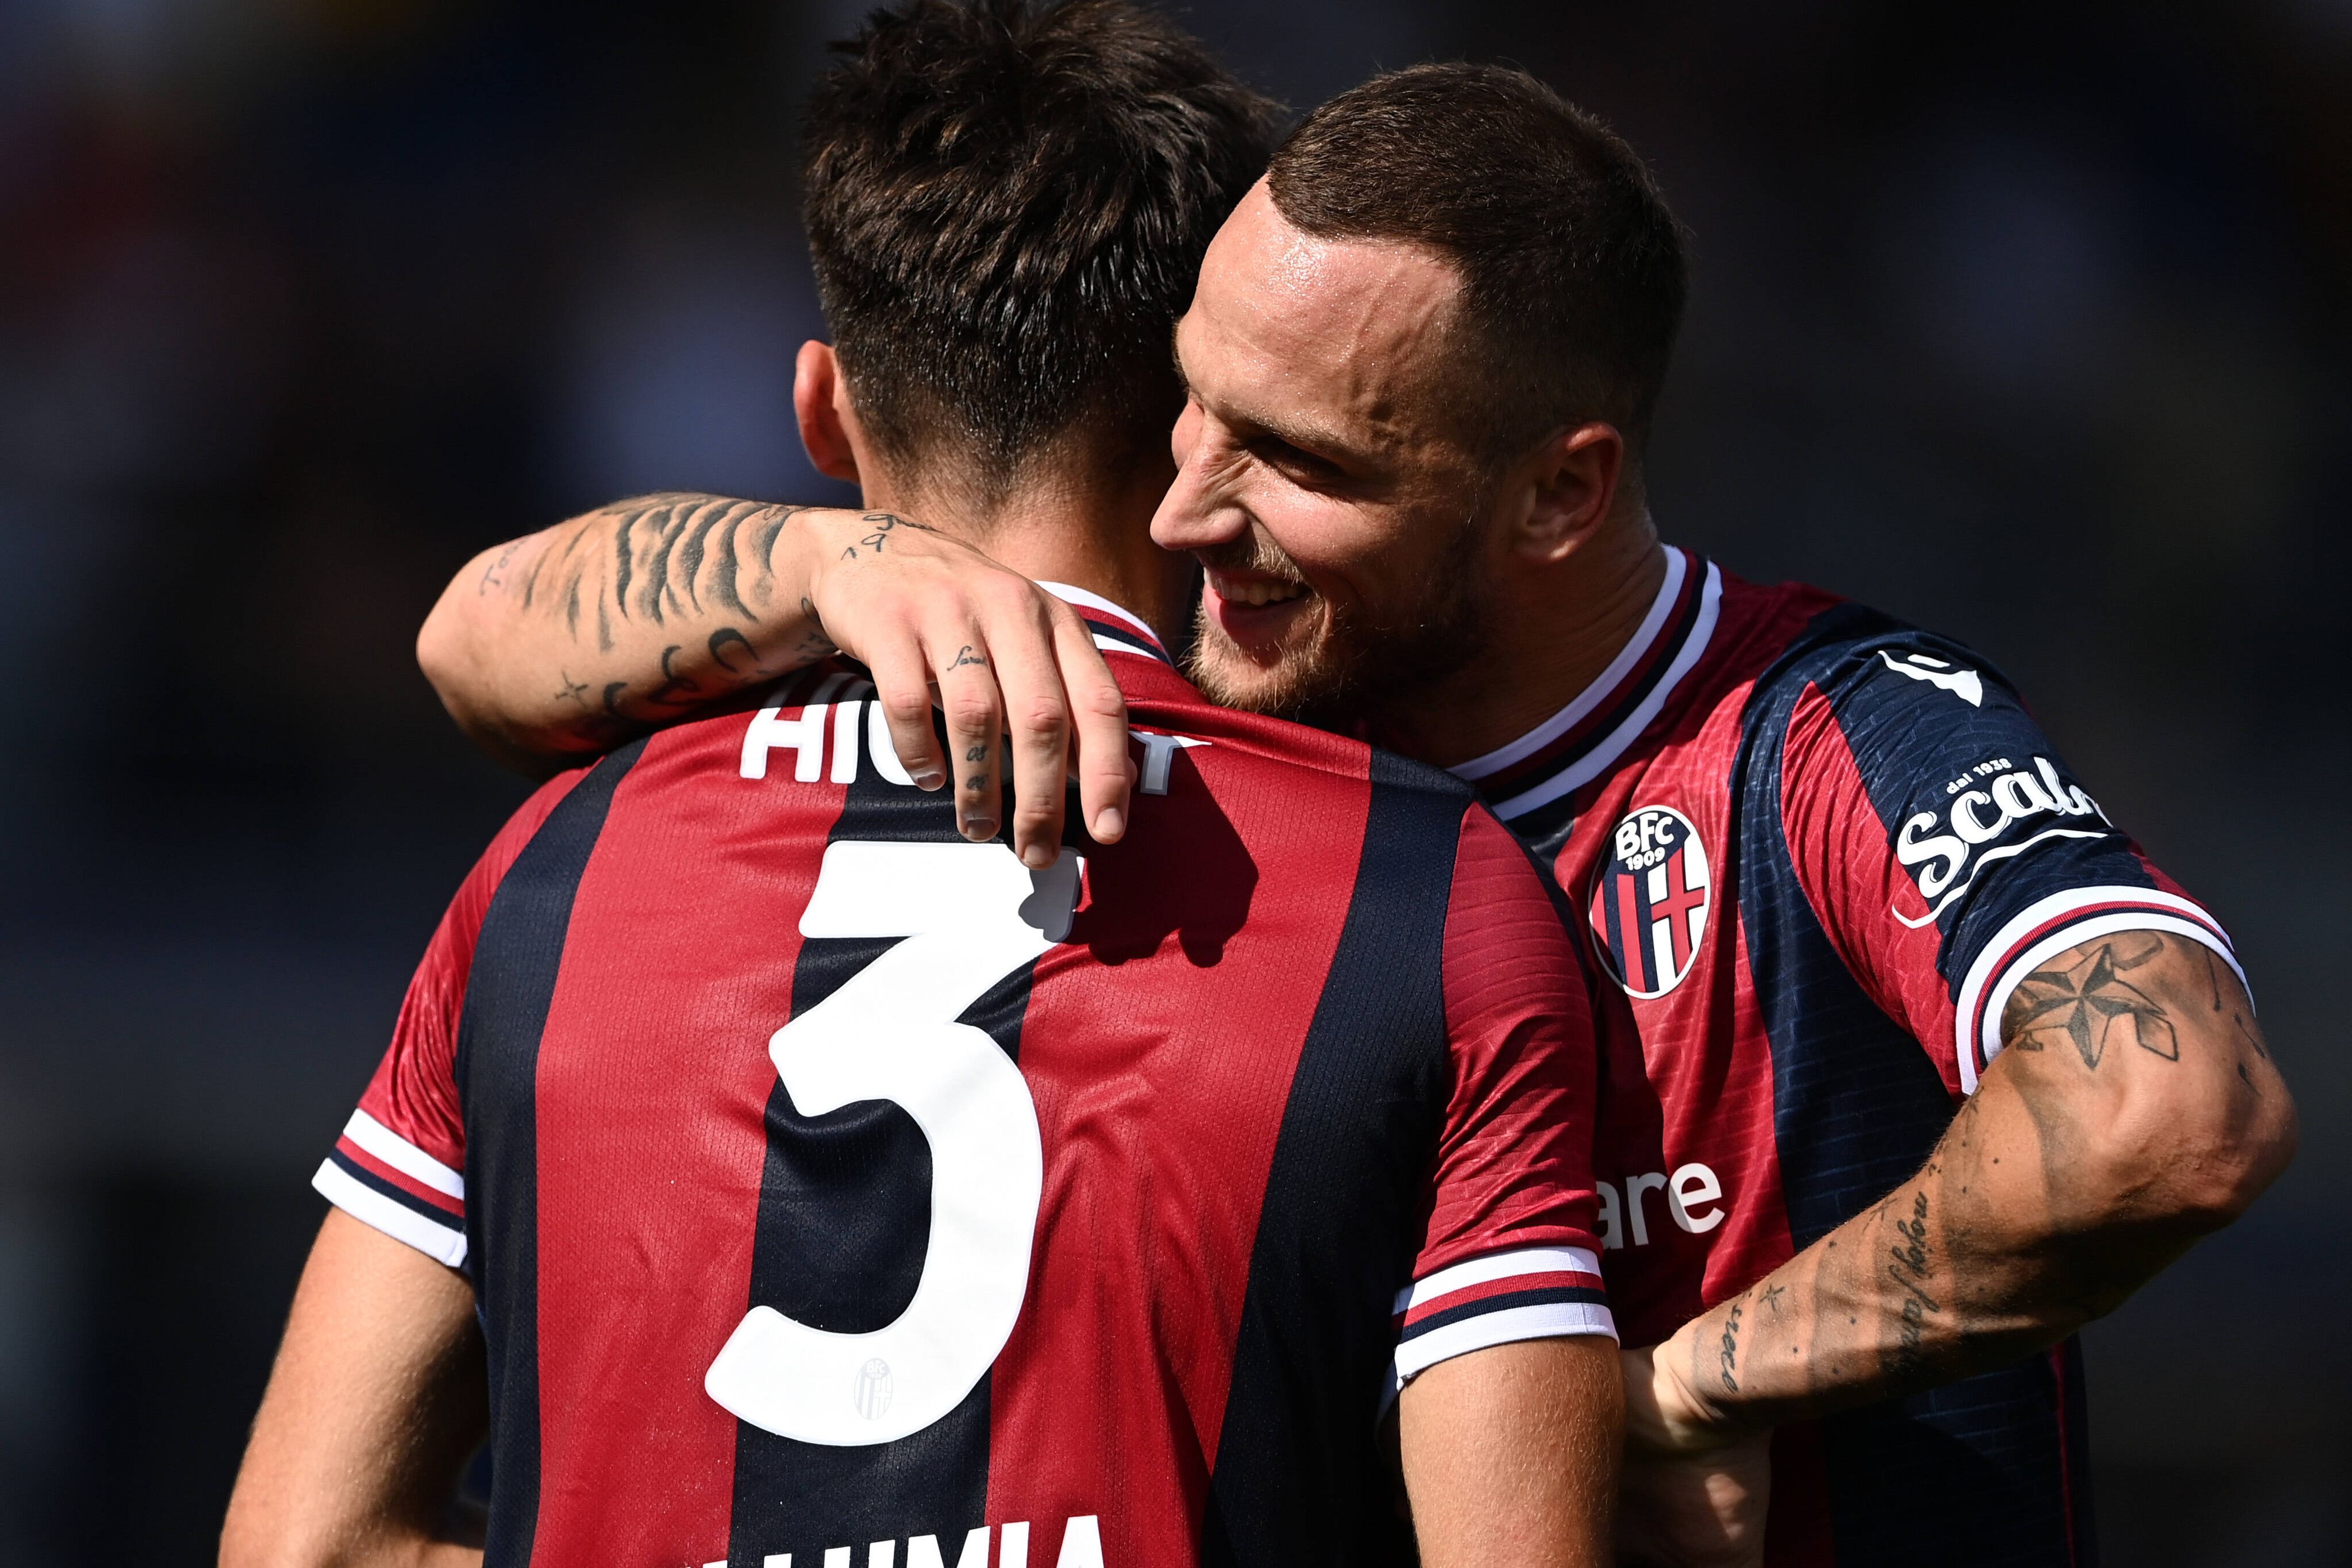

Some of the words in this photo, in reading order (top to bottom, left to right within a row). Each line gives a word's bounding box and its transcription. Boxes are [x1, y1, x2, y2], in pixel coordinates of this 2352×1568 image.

[1946, 773, 1974, 794] dal
[1973, 758, 2012, 776] 1938
[1615, 813, 1674, 861] BFC
[1625, 847, 1665, 871] 1909
[705, 840, 1081, 1447] 3
